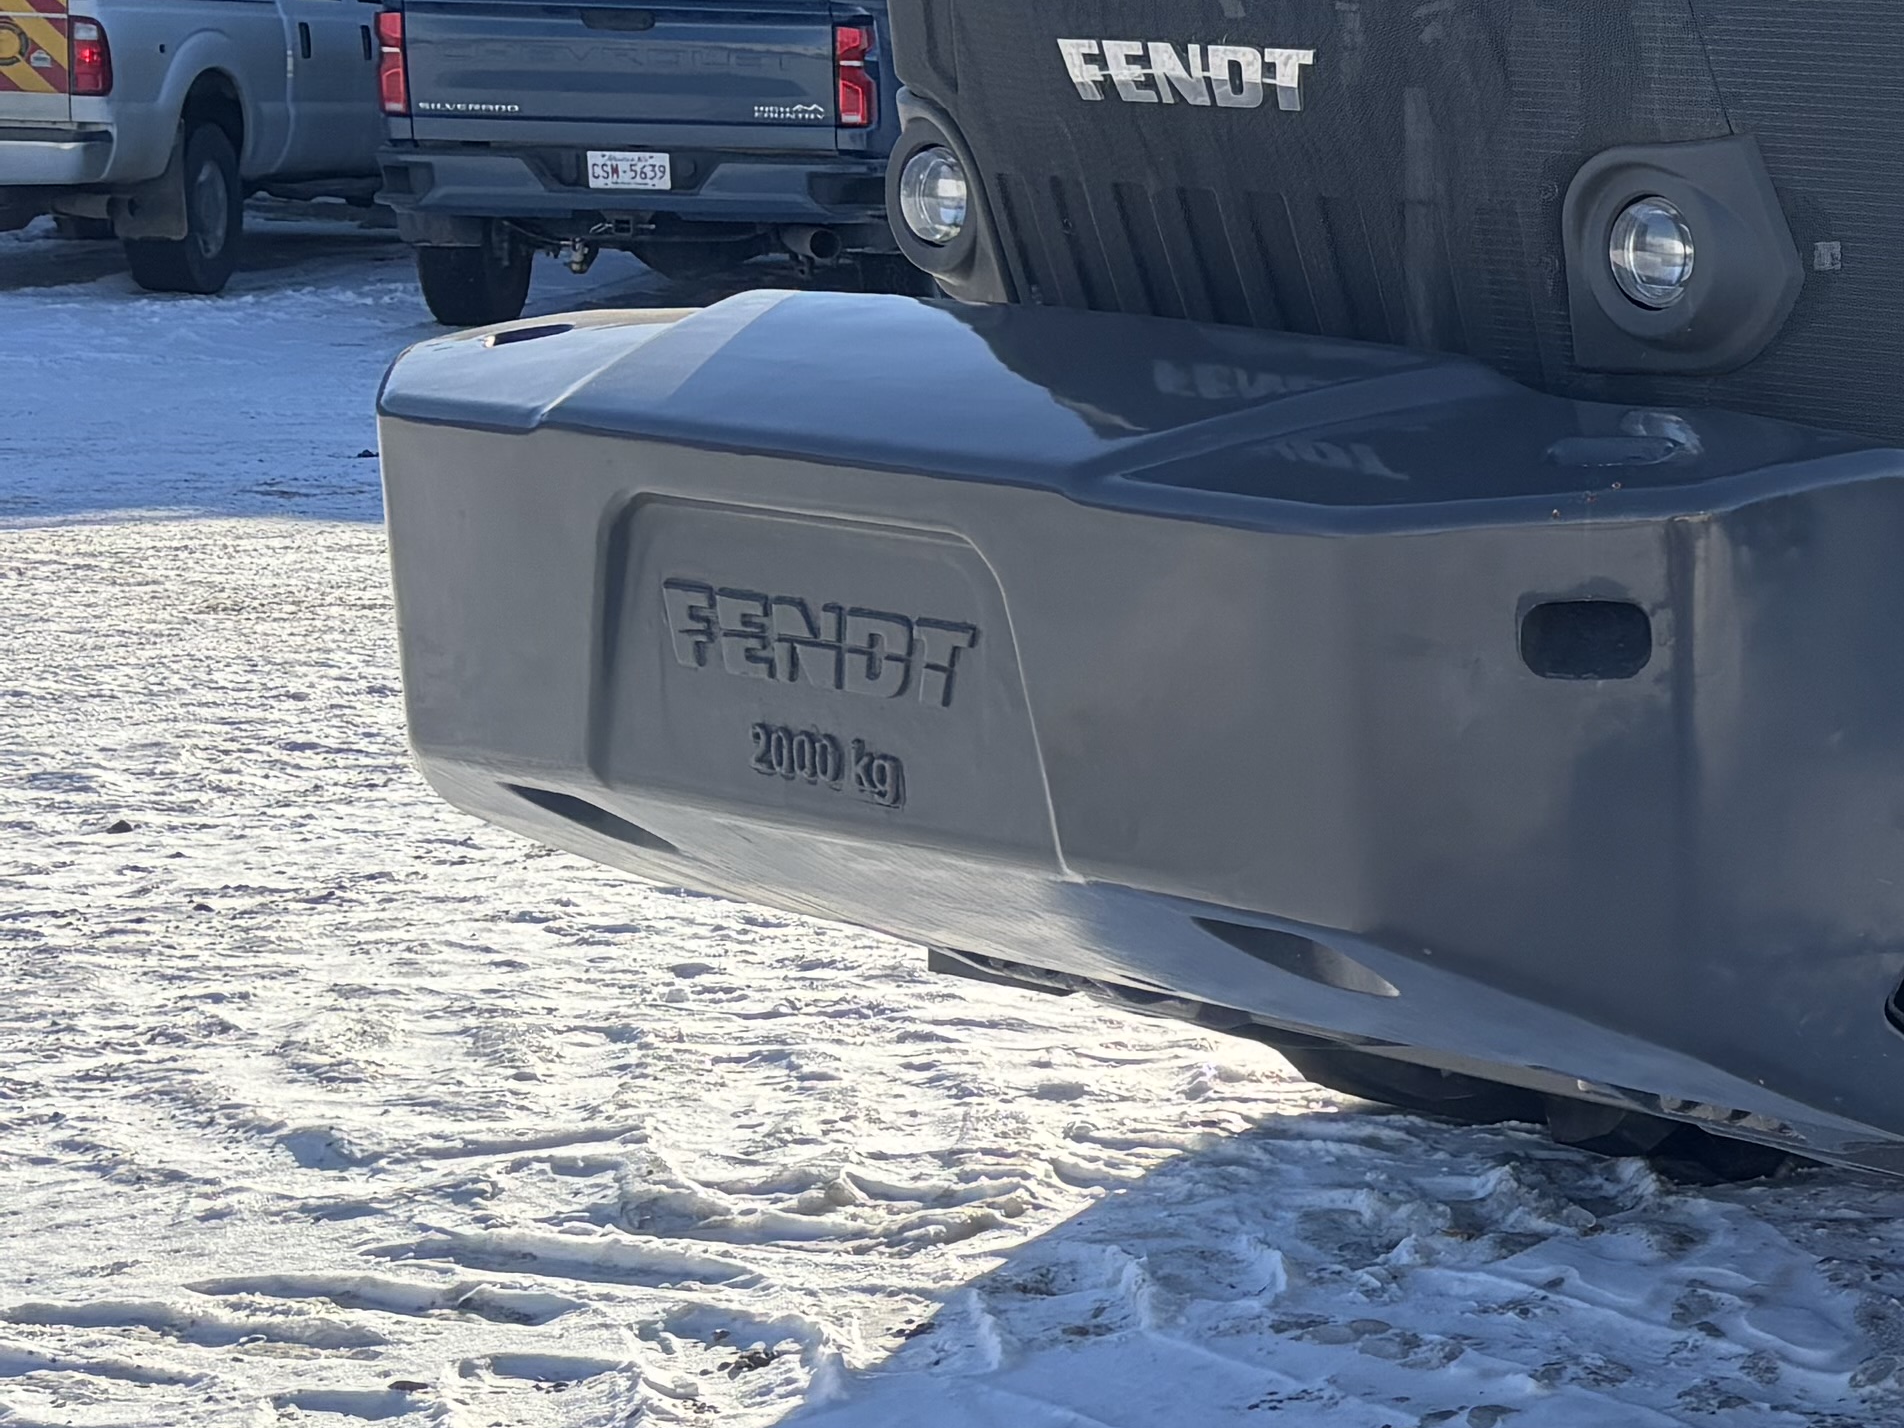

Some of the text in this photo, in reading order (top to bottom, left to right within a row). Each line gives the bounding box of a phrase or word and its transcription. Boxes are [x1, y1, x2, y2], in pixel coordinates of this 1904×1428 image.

[418, 102, 519, 113] SILVERADO
[1057, 38, 1316, 111] FENDT
[663, 577, 980, 707] FENDT
[750, 723, 906, 809] 2000 kg
